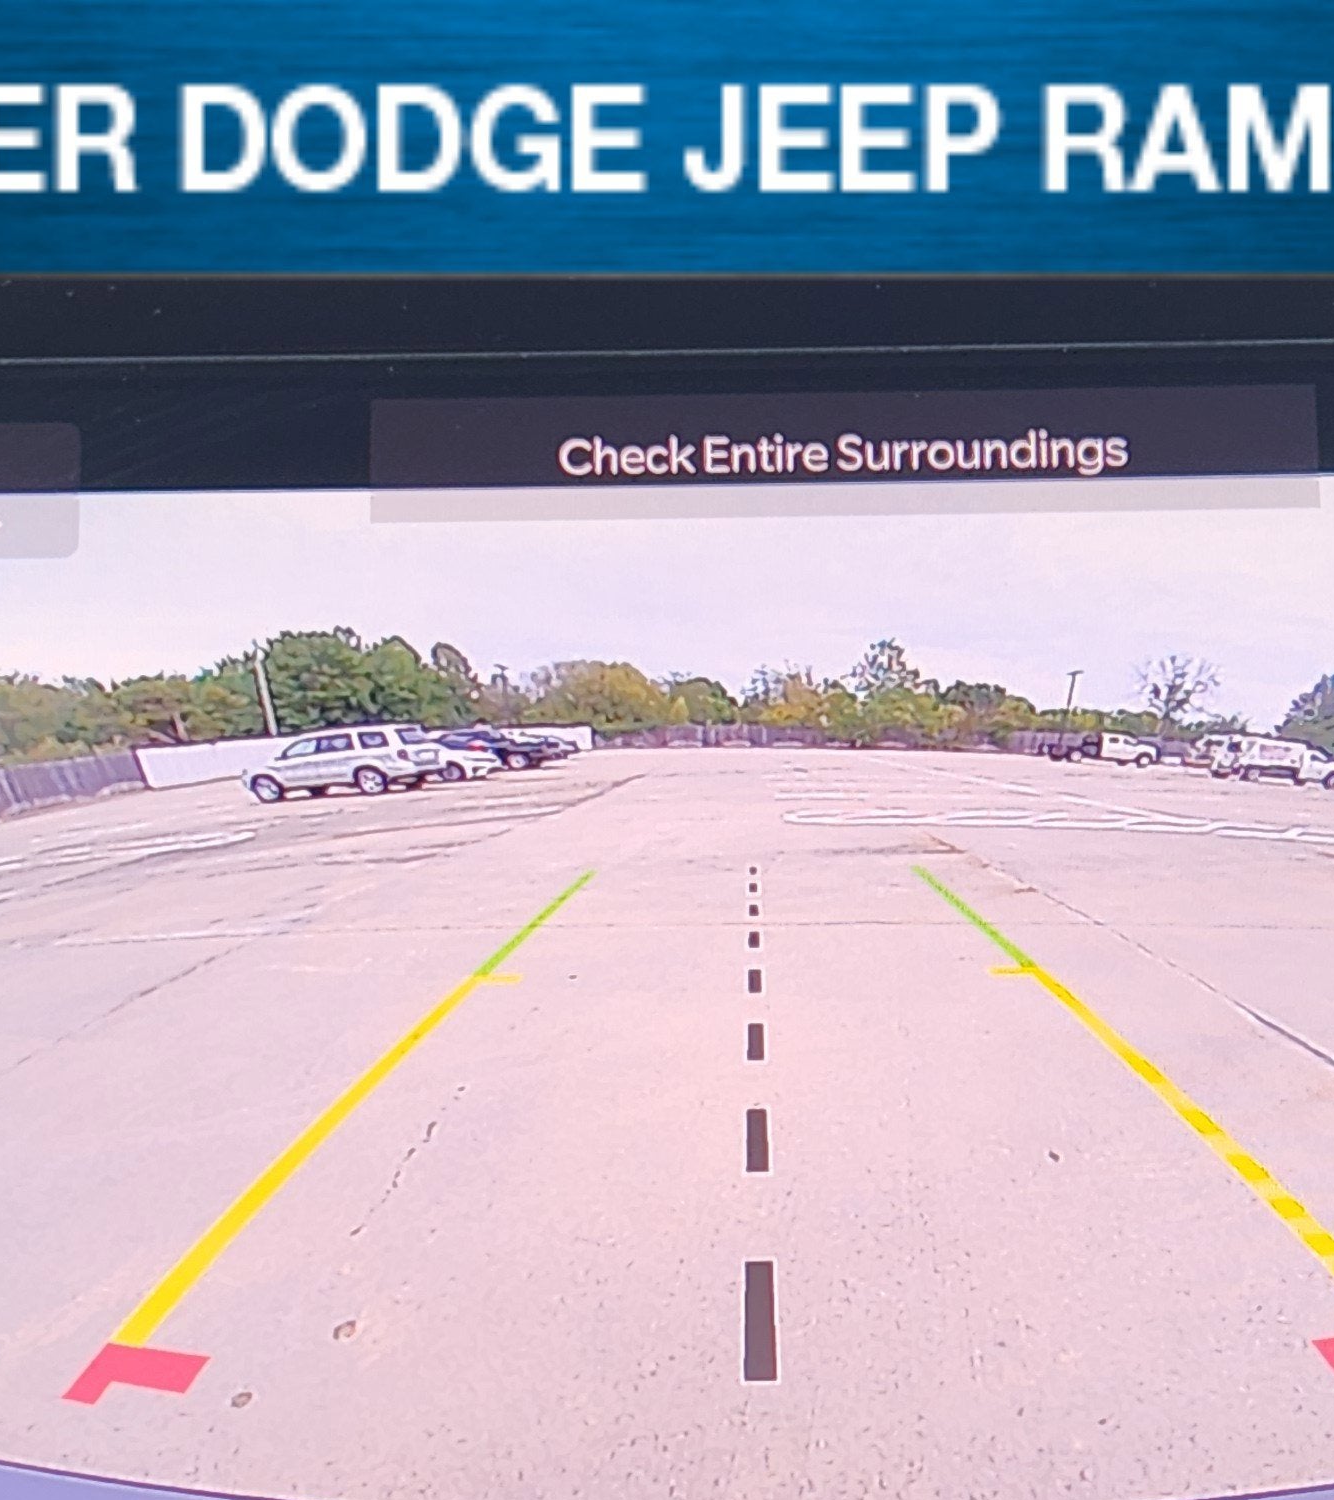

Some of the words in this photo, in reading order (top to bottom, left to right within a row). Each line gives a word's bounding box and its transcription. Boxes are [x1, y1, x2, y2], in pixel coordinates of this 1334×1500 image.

[558, 435, 696, 477] Check
[702, 433, 830, 475] Entire
[835, 429, 1130, 476] Surroundings
